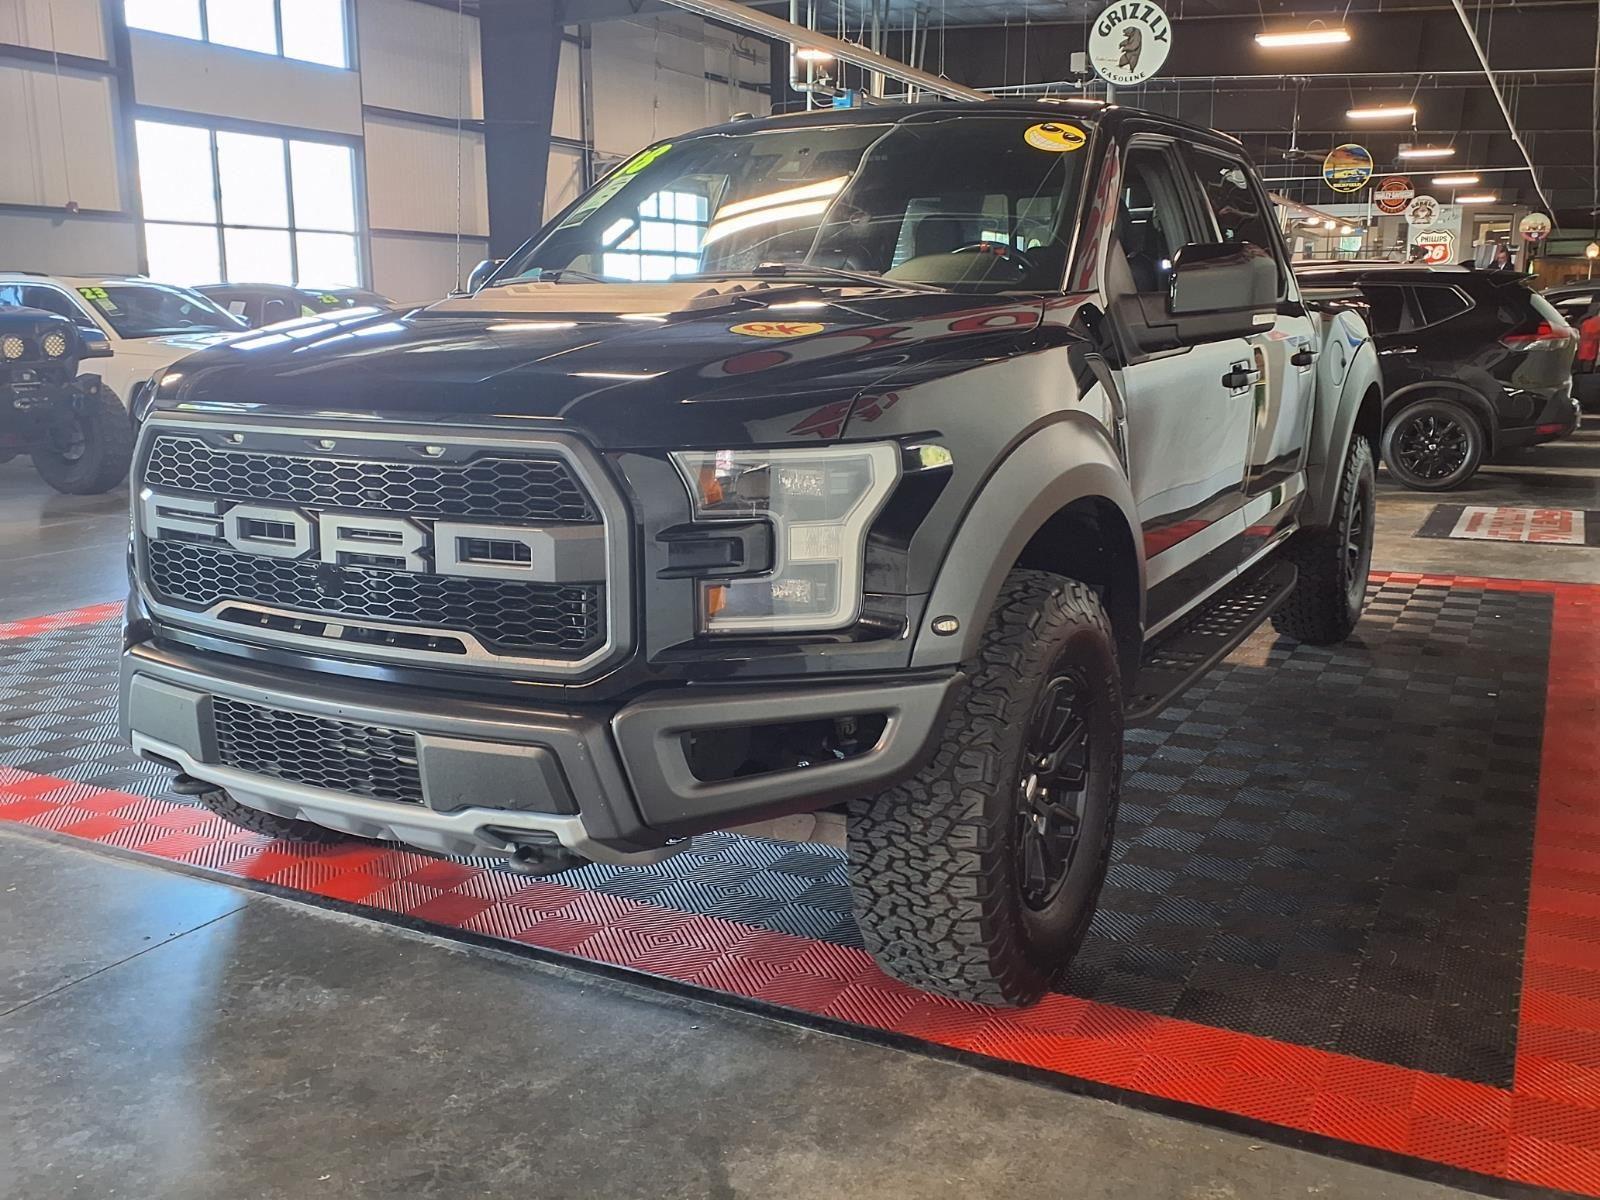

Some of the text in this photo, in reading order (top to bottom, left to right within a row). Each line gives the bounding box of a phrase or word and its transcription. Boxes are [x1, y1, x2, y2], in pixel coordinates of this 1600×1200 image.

[1097, 2, 1168, 43] GRIZZLY
[1101, 66, 1146, 82] GASOLINE
[1420, 235, 1448, 243] PHILLIPS
[140, 493, 557, 584] FORD
